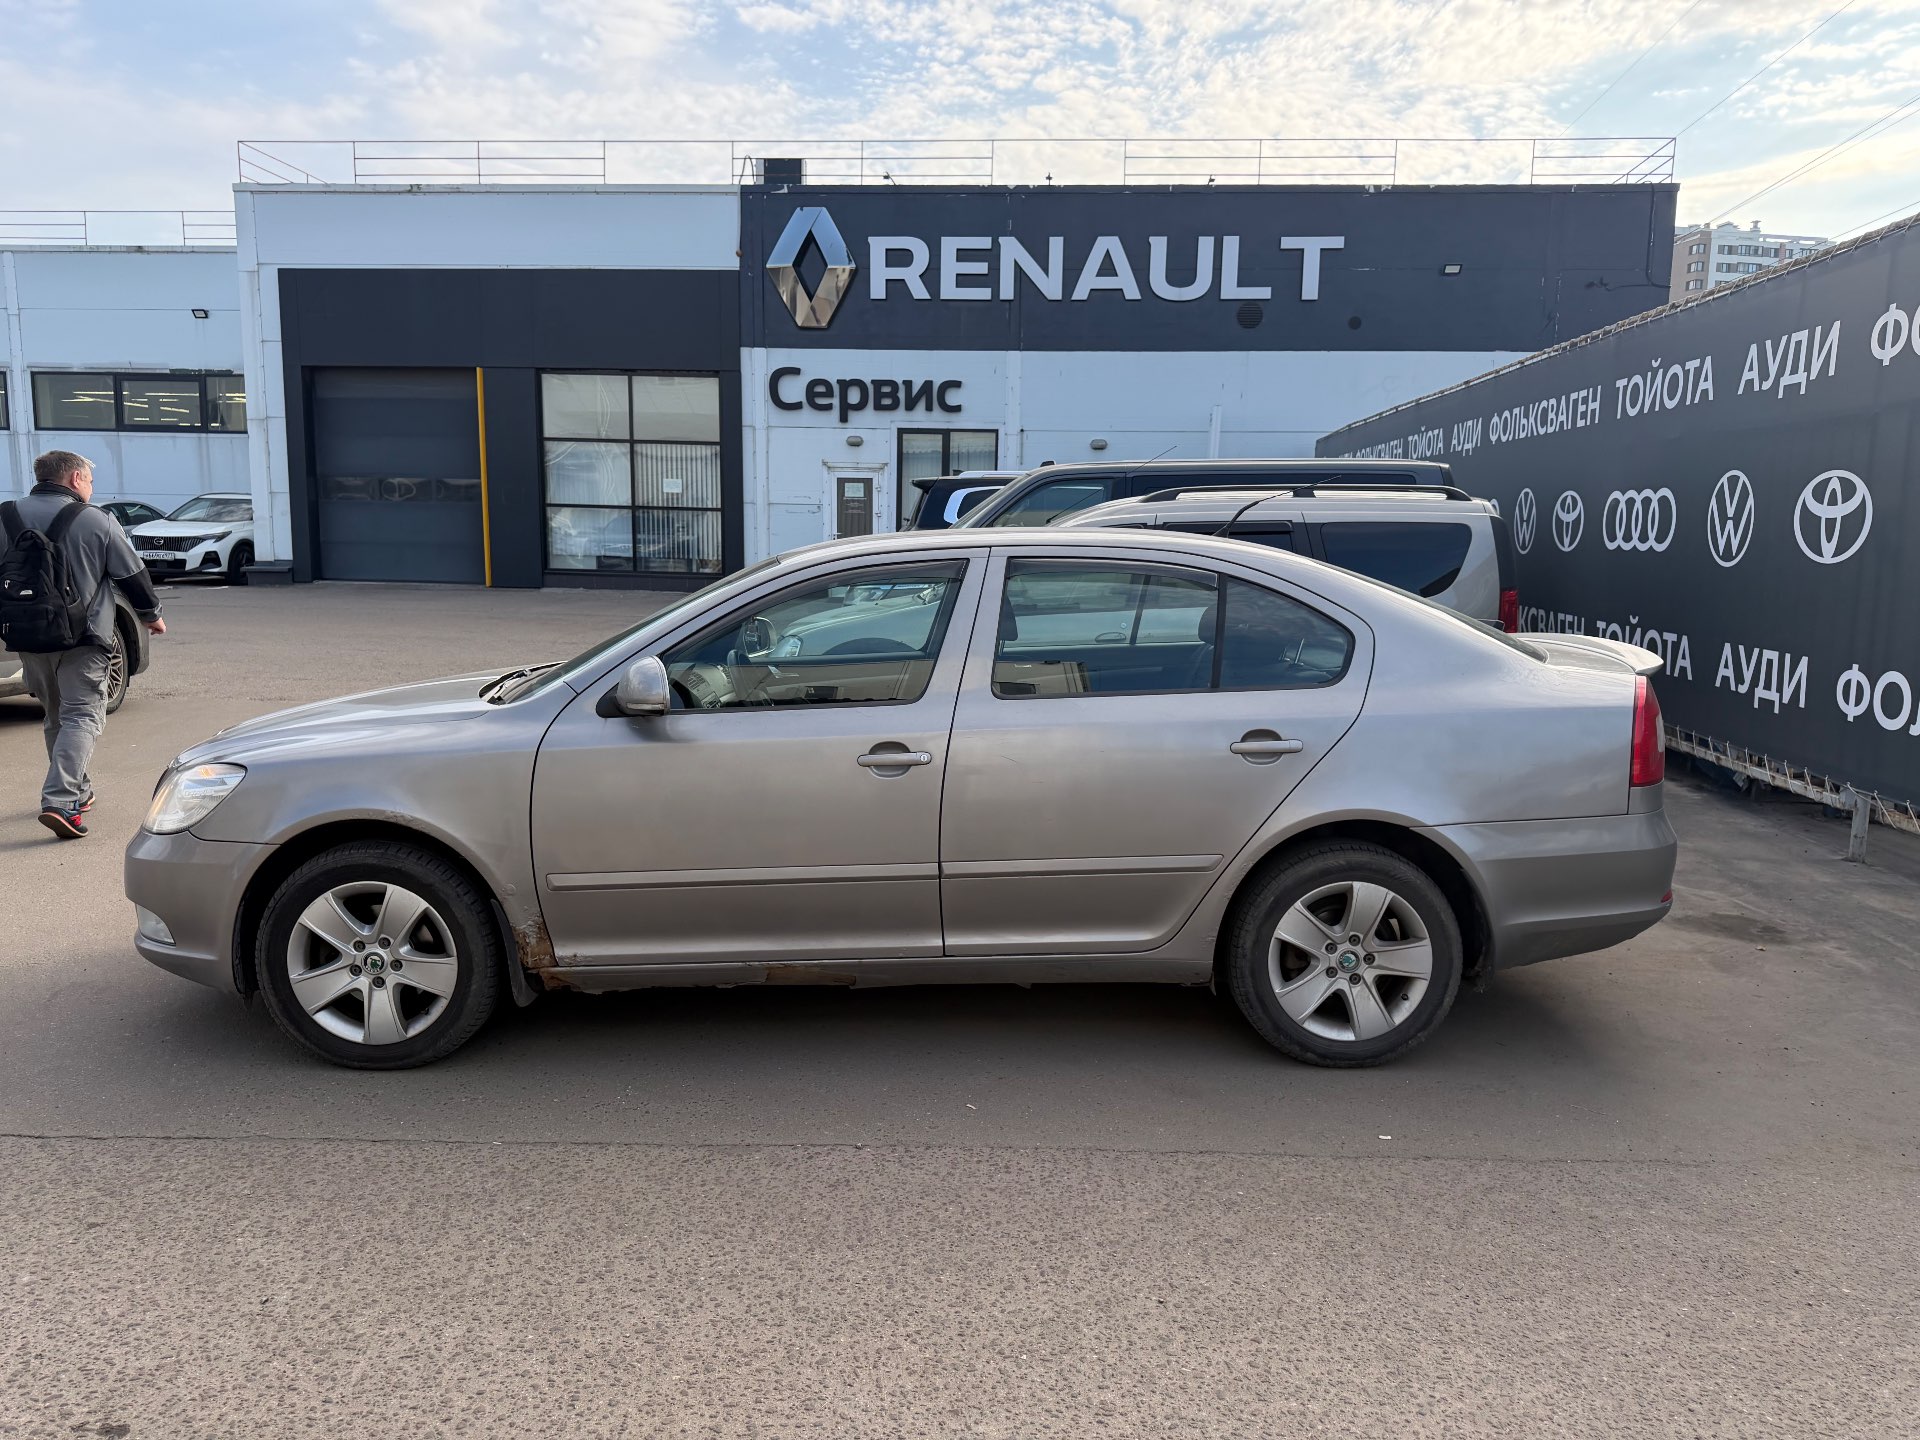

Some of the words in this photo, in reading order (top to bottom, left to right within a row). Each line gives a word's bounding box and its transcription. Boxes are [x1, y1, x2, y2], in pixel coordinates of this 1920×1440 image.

[868, 236, 1345, 301] RENAULT
[769, 367, 963, 423] Сервис
[1408, 425, 1444, 459] ТОЙОТА
[1450, 417, 1483, 456] АУДИ
[1489, 385, 1602, 445] ФОЛЬКСВАГЕН
[1615, 356, 1714, 419] ТОЙОТА
[1737, 320, 1841, 399] АУДИ
[1870, 303, 1920, 366] Ф
[1715, 642, 1809, 714] АУДИ
